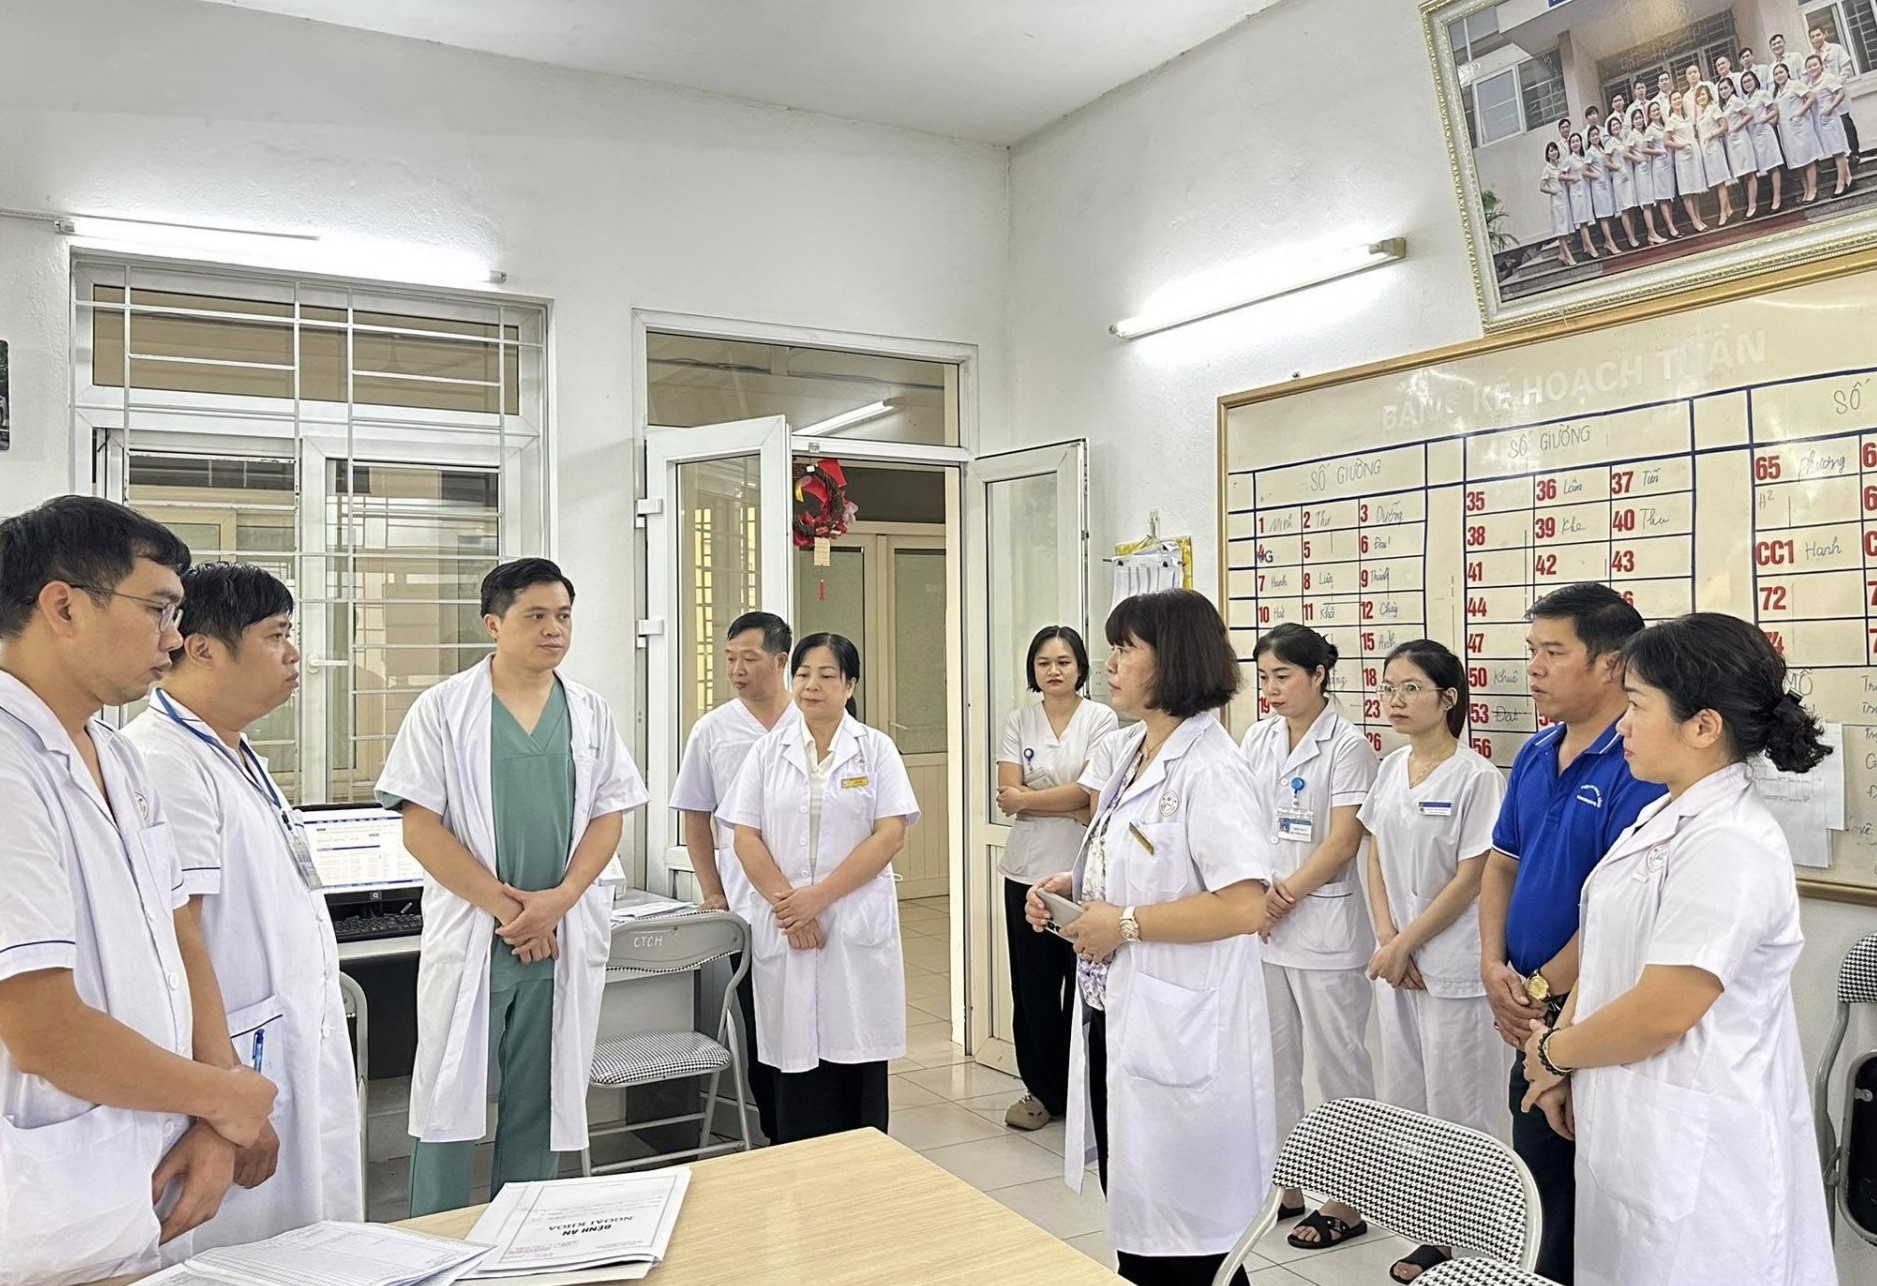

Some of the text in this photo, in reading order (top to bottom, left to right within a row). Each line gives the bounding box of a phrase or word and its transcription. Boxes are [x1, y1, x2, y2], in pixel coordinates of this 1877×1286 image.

[1522, 355, 1643, 406] HOẠCH
[1833, 378, 1871, 415] SỐ
[1508, 423, 1592, 459] SỐ GIƯỜNG
[1310, 457, 1382, 492] SỐ GIƯỜNG
[1755, 455, 1781, 481] 65
[1536, 478, 1557, 502] 36
[1611, 470, 1634, 495] 37
[1466, 491, 1485, 512] 35
[1303, 511, 1311, 529] 2
[1360, 504, 1369, 523] 3
[1612, 508, 1636, 533] 40
[1259, 517, 1265, 534] 1
[1467, 526, 1486, 546] 38
[1535, 516, 1556, 540] 39
[1303, 541, 1311, 559] 5
[1360, 535, 1369, 554] 6
[1755, 538, 1795, 567] CC1
[1535, 553, 1557, 577] 42
[1611, 549, 1635, 574] 43
[1303, 572, 1311, 590] 8
[1360, 569, 1369, 588] 9
[1467, 562, 1482, 583] 41
[1258, 575, 1265, 592] 7
[1467, 596, 1488, 618] 44
[1759, 585, 1787, 612] 72
[1258, 606, 1269, 624] 10
[1303, 602, 1313, 621] 11
[1360, 601, 1374, 620] 12
[1361, 632, 1375, 652] 15
[1467, 633, 1485, 654] 47
[1363, 668, 1377, 687] 18
[1468, 667, 1488, 688] 50
[1258, 696, 1270, 714] 19
[1364, 699, 1381, 718] 23
[1470, 703, 1489, 725] 53
[1366, 732, 1382, 752] 26
[1471, 738, 1492, 759] 56
[634, 936, 663, 948] CTCH
[548, 1220, 586, 1232] KHOA
